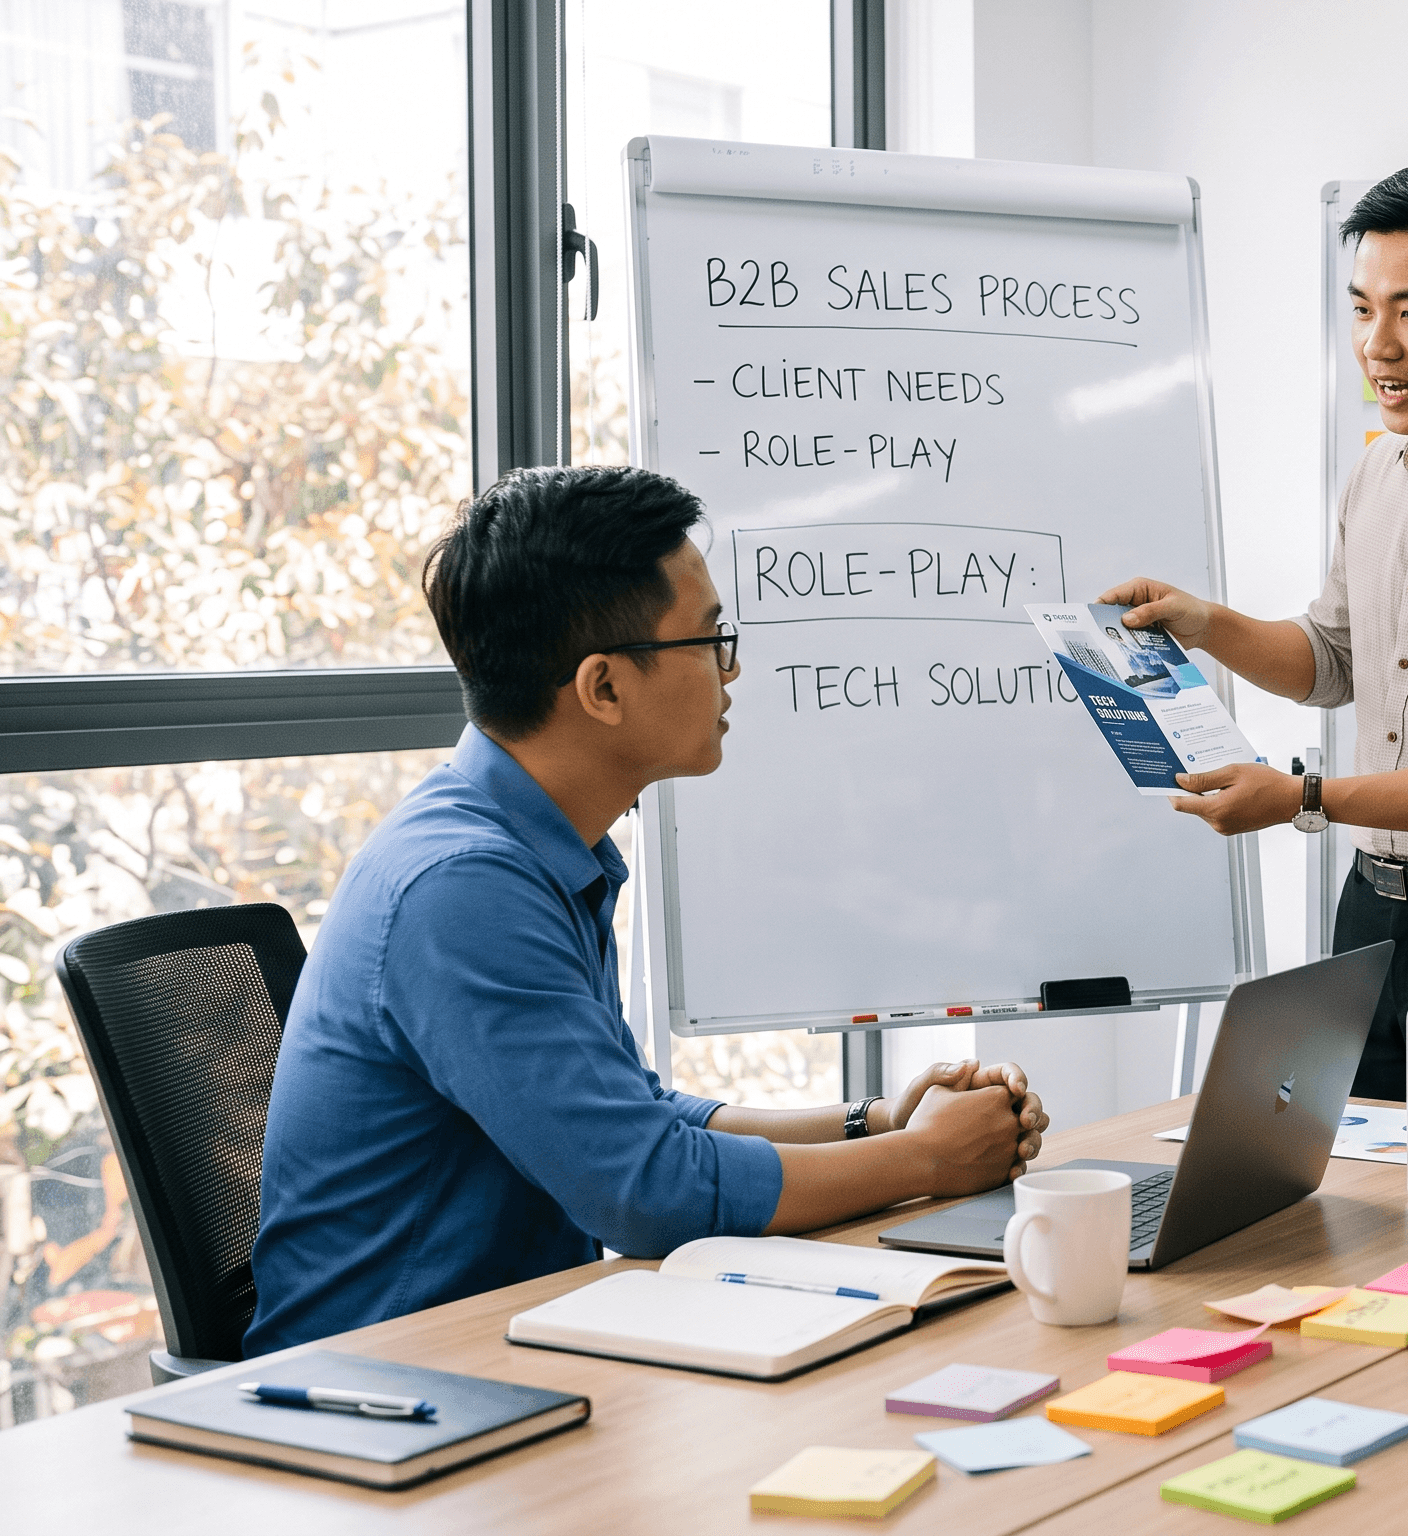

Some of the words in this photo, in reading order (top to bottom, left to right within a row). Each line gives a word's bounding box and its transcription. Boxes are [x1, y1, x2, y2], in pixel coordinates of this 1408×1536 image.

[706, 257, 799, 308] B2B
[827, 264, 953, 315] SALES
[978, 274, 1140, 325] PROCESS
[887, 369, 1005, 406] NEEDS
[743, 430, 957, 484] ROLE-PLAY
[774, 664, 900, 713] TECH
[1088, 695, 1118, 707] TECH
